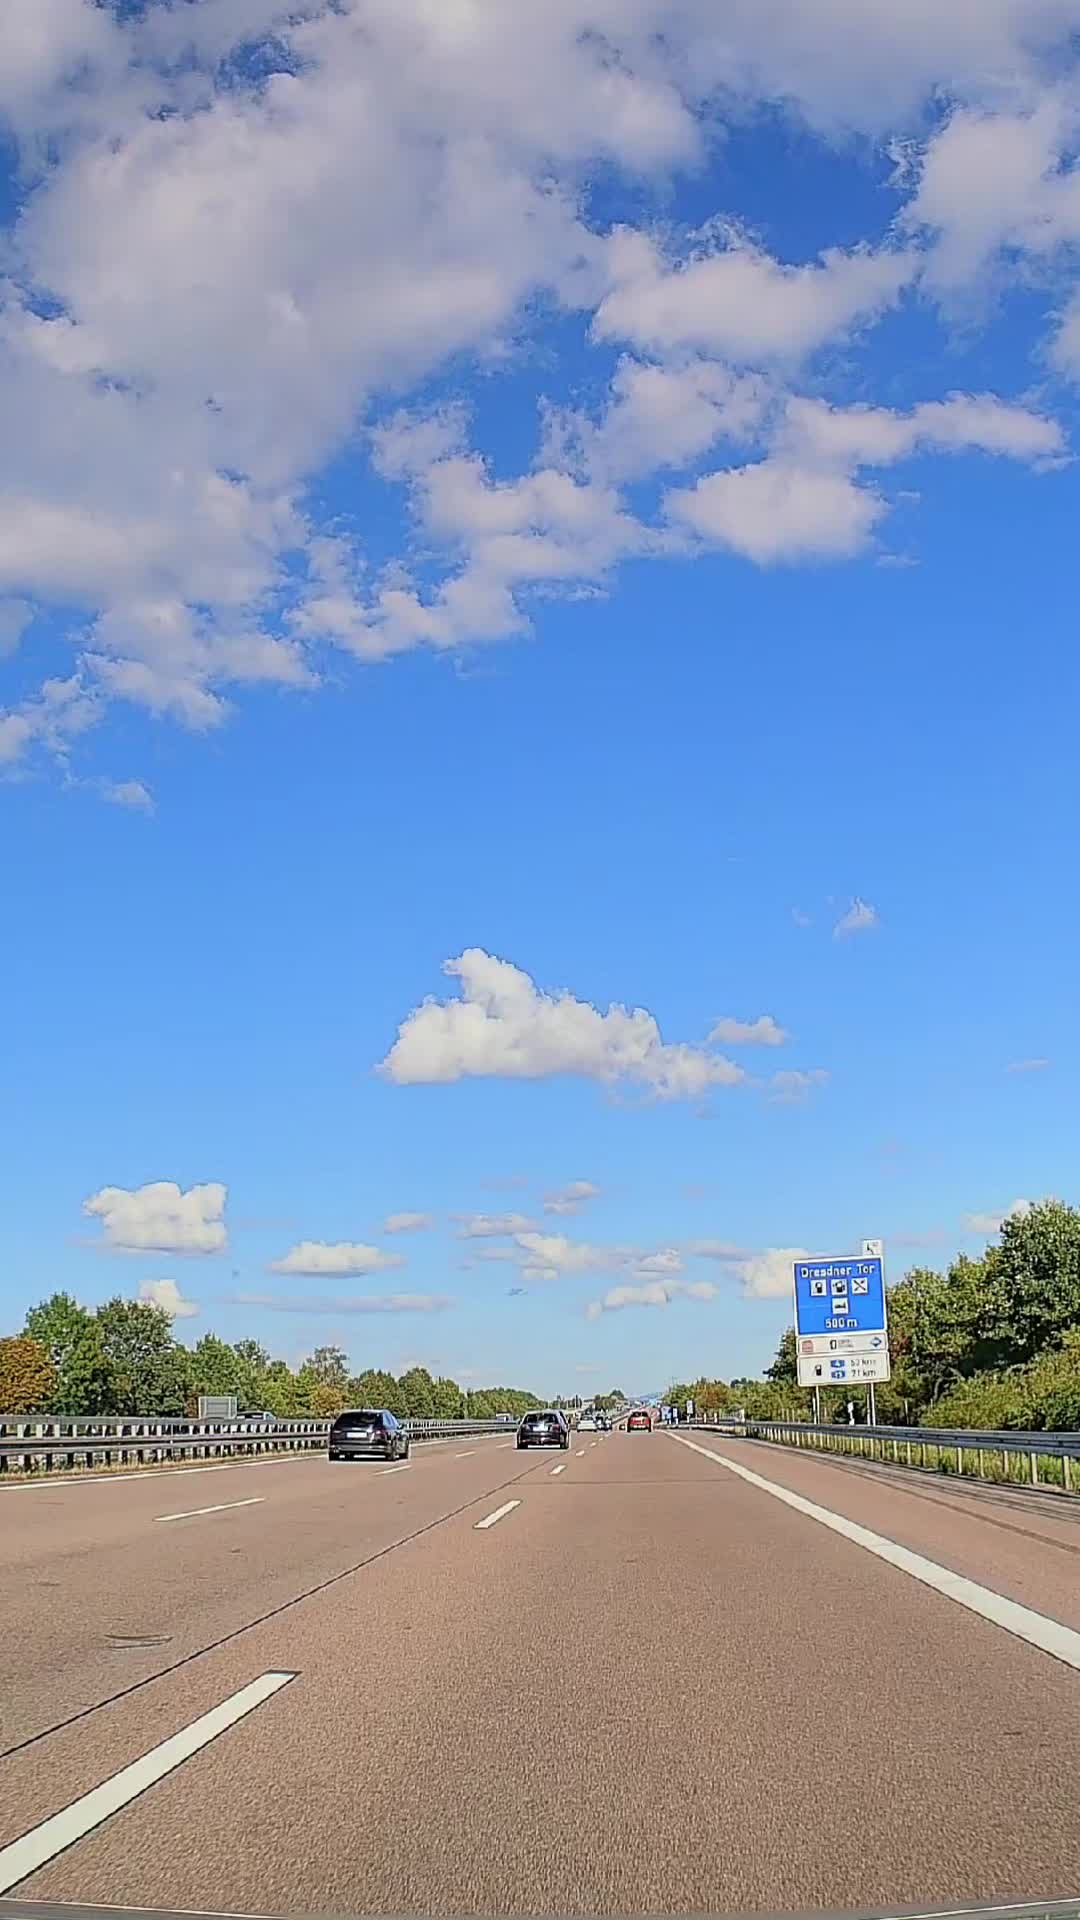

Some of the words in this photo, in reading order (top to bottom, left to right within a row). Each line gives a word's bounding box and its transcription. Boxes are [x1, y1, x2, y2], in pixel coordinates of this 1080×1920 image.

[801, 1265, 852, 1278] Dresdner
[857, 1263, 875, 1275] Tor
[825, 1317, 845, 1328] 500
[847, 1318, 857, 1328] m
